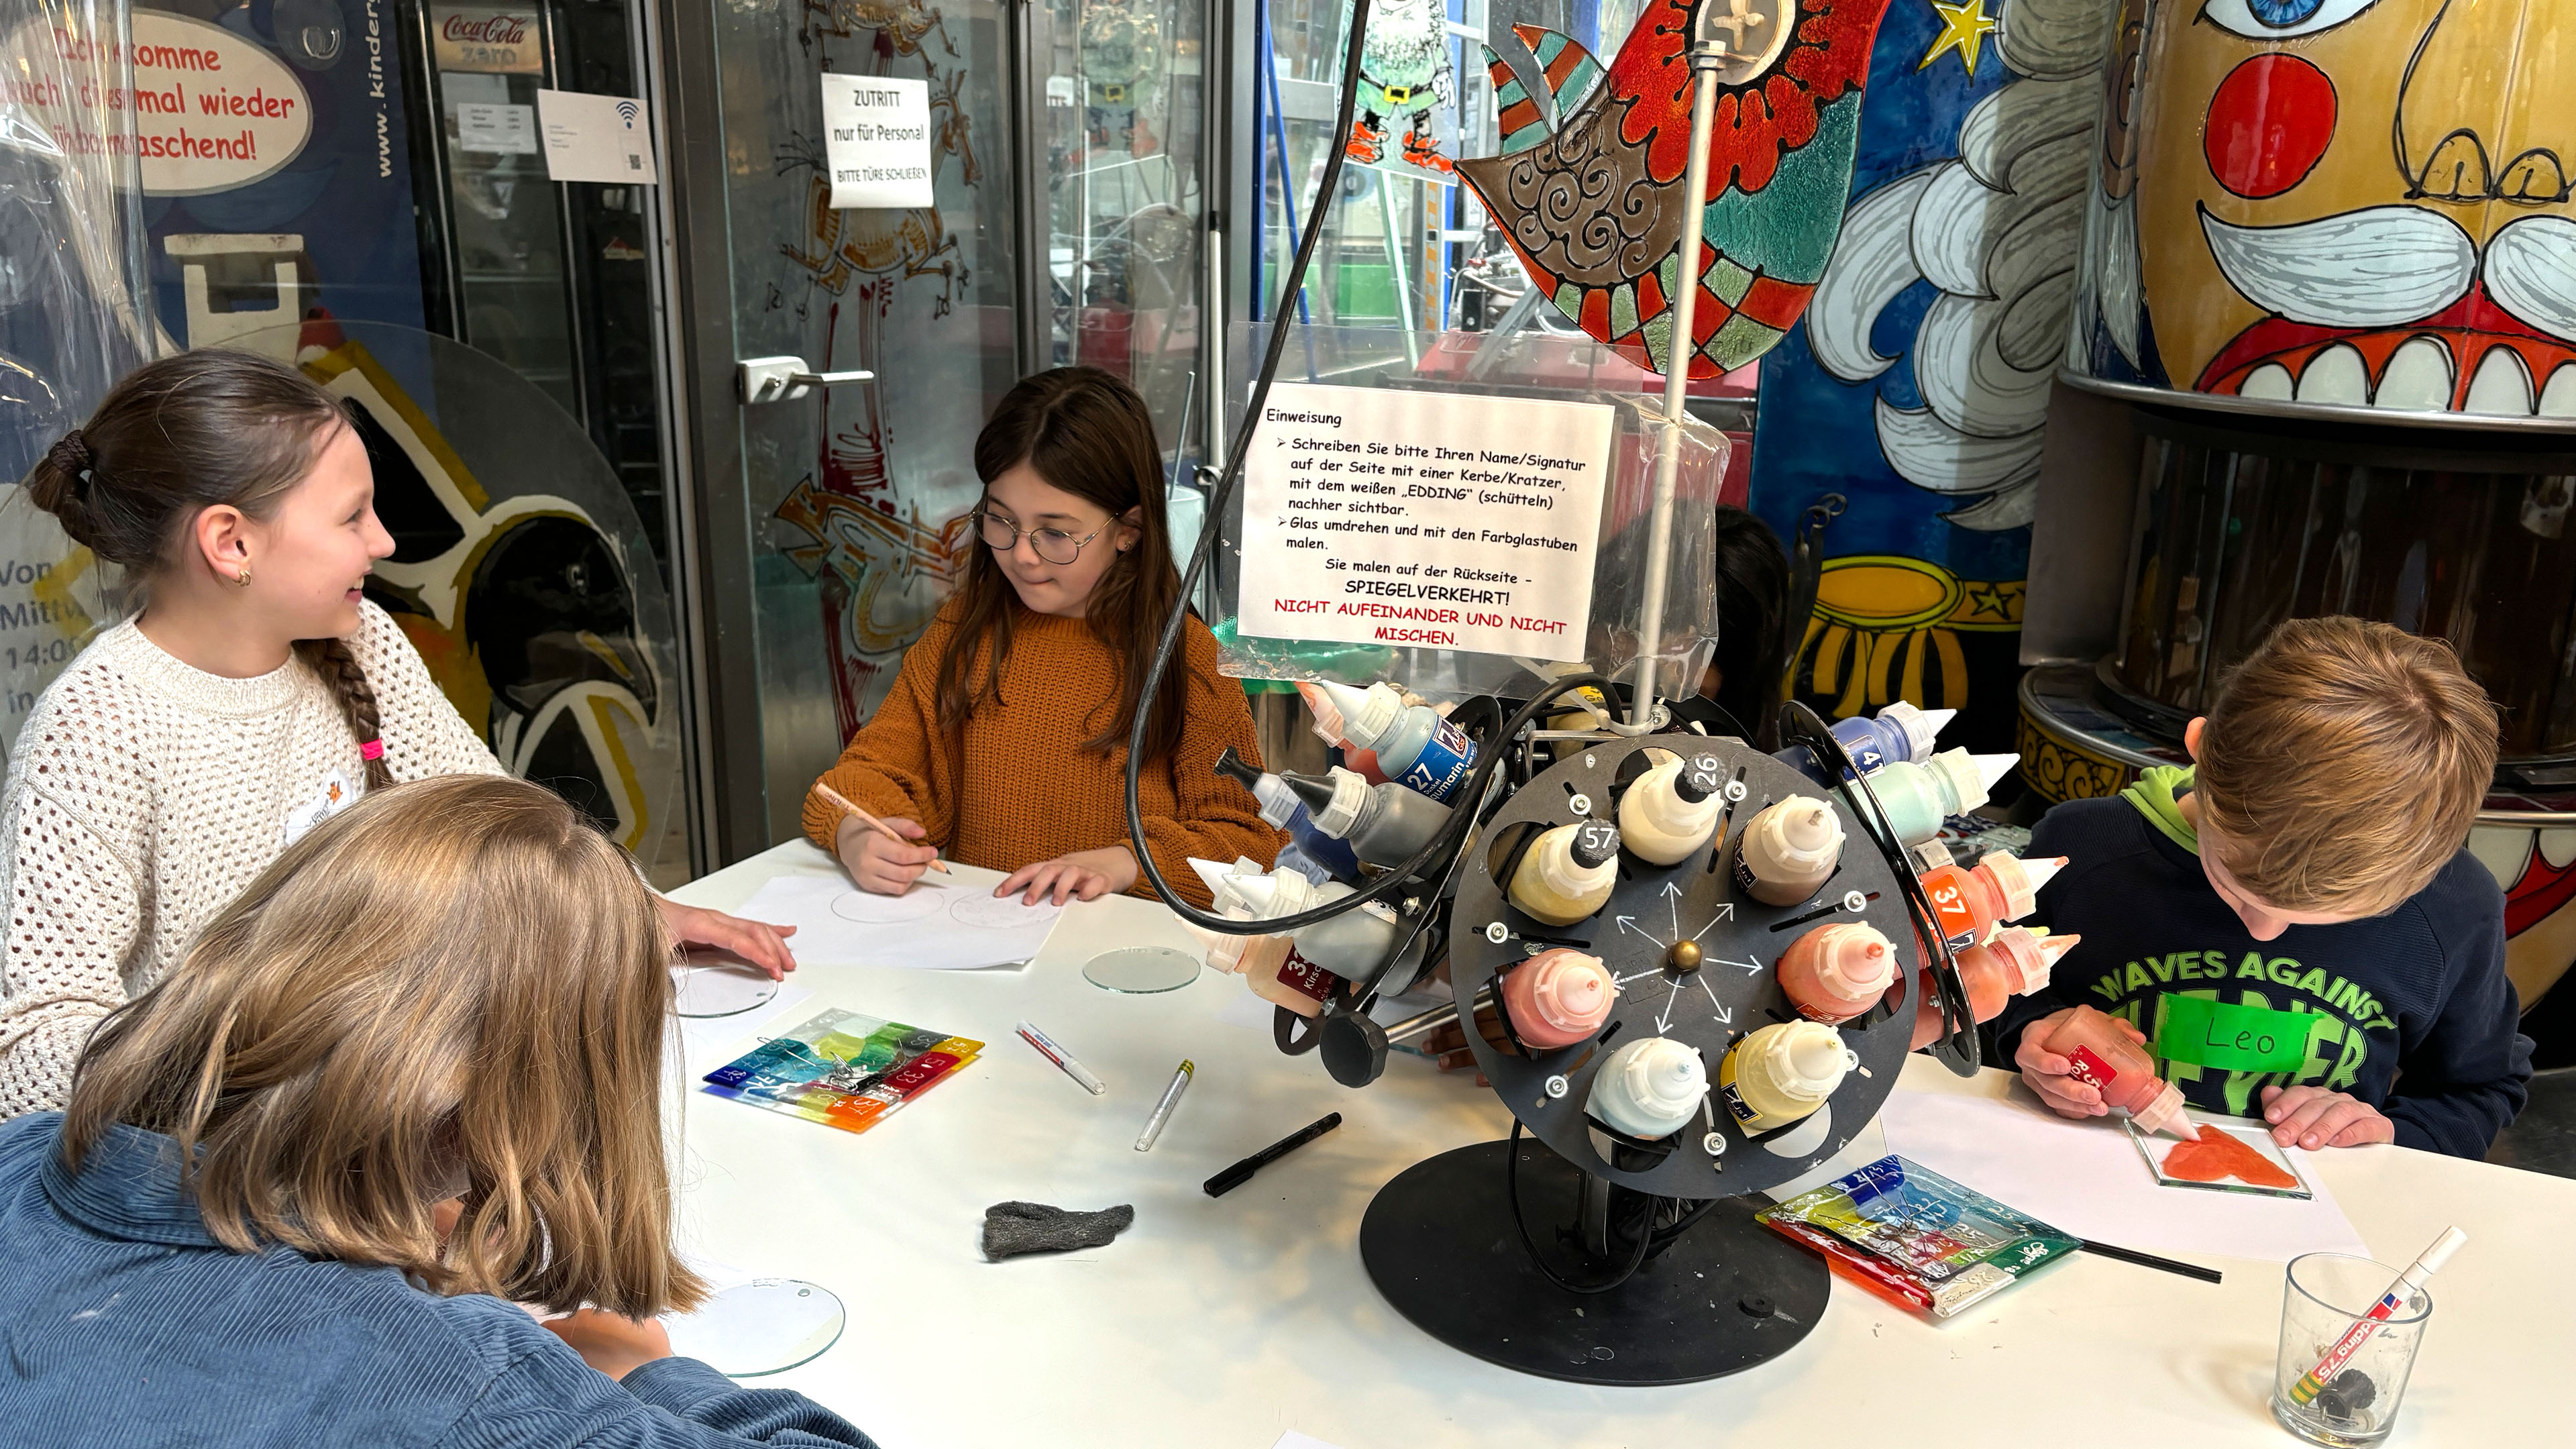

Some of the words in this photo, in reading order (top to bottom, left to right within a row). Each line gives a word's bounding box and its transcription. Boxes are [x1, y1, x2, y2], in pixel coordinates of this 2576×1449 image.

[461, 46, 517, 65] zero
[199, 87, 294, 119] wieder
[365, 0, 392, 178] www.kinder
[853, 89, 901, 107] ZUTRITT
[833, 128, 855, 142] nur
[857, 123, 875, 141] für
[876, 123, 925, 142] Personal
[837, 169, 861, 183] BITTE
[862, 166, 885, 182] TÜRE
[1267, 409, 1342, 428] Einweisung
[1291, 437, 1361, 453] Schreiben
[1366, 443, 1389, 455] Sie
[1395, 443, 1430, 458] bitte
[1435, 447, 1474, 462] Ihren
[1479, 450, 1586, 472] Name/Signatur
[1291, 458, 1313, 470] auf
[1319, 459, 1343, 472] der
[1348, 461, 1386, 474] Seite
[1391, 464, 1413, 477] mit
[1419, 466, 1454, 480] einer
[1460, 468, 1566, 492] Kerbe/Kratzer,
[1288, 498, 1342, 511] nachher
[1348, 500, 1409, 517] sichtbar.
[1289, 478, 1311, 490] mit
[1318, 478, 1345, 492] dem
[1350, 482, 1396, 496] weißen
[1479, 489, 1554, 511] (schütteln)
[1286, 537, 1328, 550] malen.
[1290, 517, 1318, 530] Glas
[1324, 519, 1389, 535] umdrehen
[1395, 524, 1419, 537] und
[1424, 526, 1446, 538] mit
[1451, 527, 1476, 541] den
[1481, 529, 1578, 553] Farbglastuben
[1325, 558, 1347, 570] Sie
[1353, 559, 1391, 574] malen
[1396, 563, 1419, 576] auf
[1424, 564, 1448, 578] der
[1453, 567, 1518, 584] Rückseite
[1344, 580, 1511, 606] SPIEGELVERKEHRT!
[1274, 598, 1331, 614] NICHT
[1336, 602, 1459, 624] AUFEINANDER
[1466, 612, 1504, 628] UND
[1509, 615, 1568, 635] NICHT
[1374, 626, 1460, 646] MISCHEN.
[1407, 761, 1434, 791] 27
[1693, 756, 1719, 787] 26
[1584, 826, 1615, 850] 57
[1933, 885, 1967, 915] 37
[2089, 949, 2229, 1004] WAVES
[2234, 951, 2400, 1031] AGAINST
[2205, 1016, 2276, 1055] Leo
